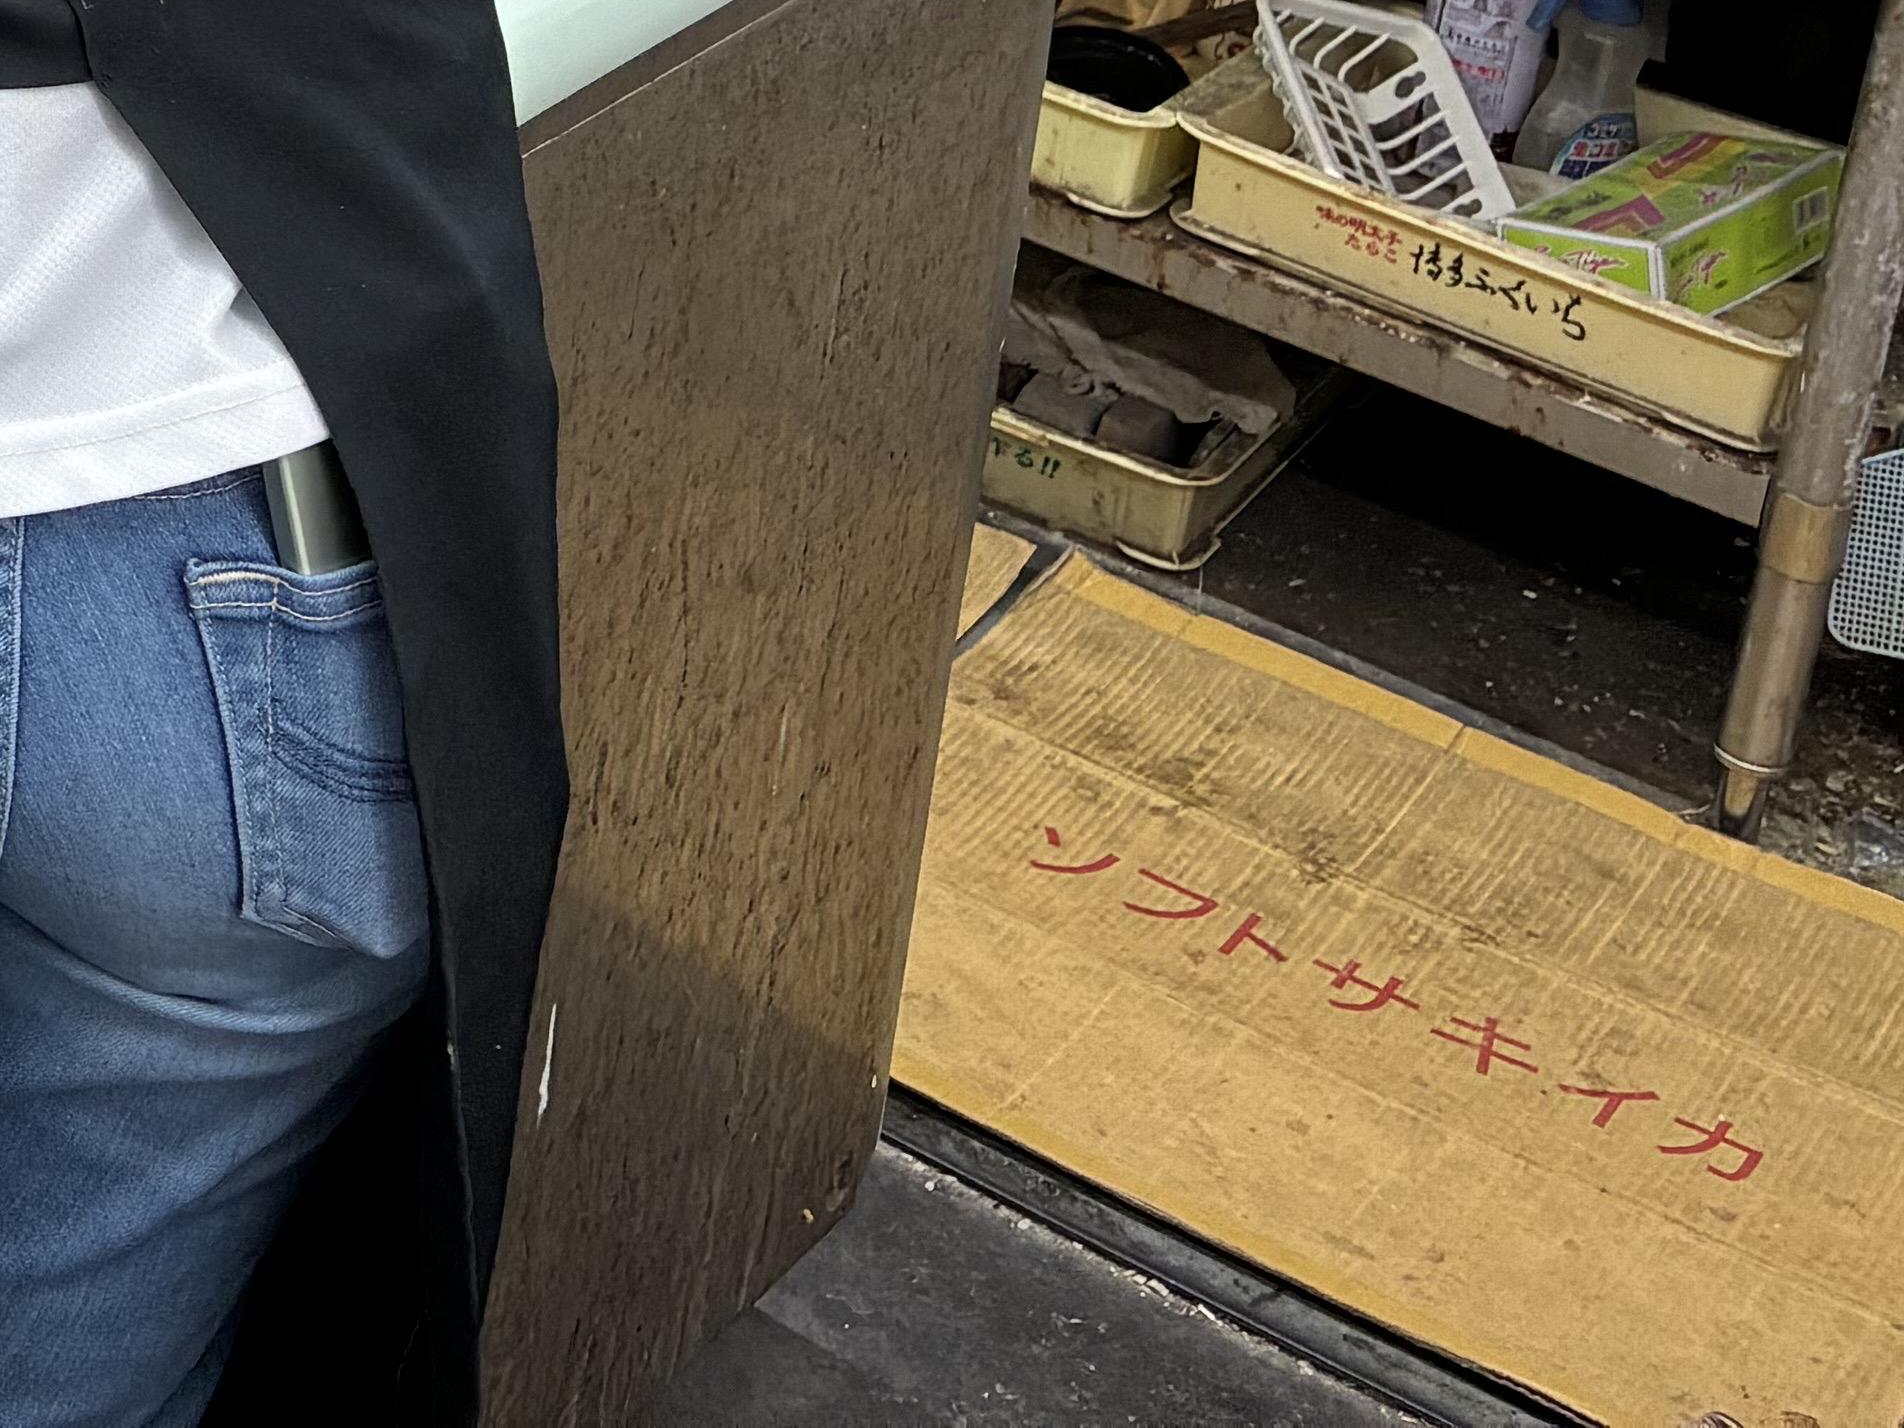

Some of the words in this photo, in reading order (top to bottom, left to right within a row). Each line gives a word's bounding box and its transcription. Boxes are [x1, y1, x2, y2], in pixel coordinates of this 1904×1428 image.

[1028, 824, 1766, 1183] ソフトサキイカ
